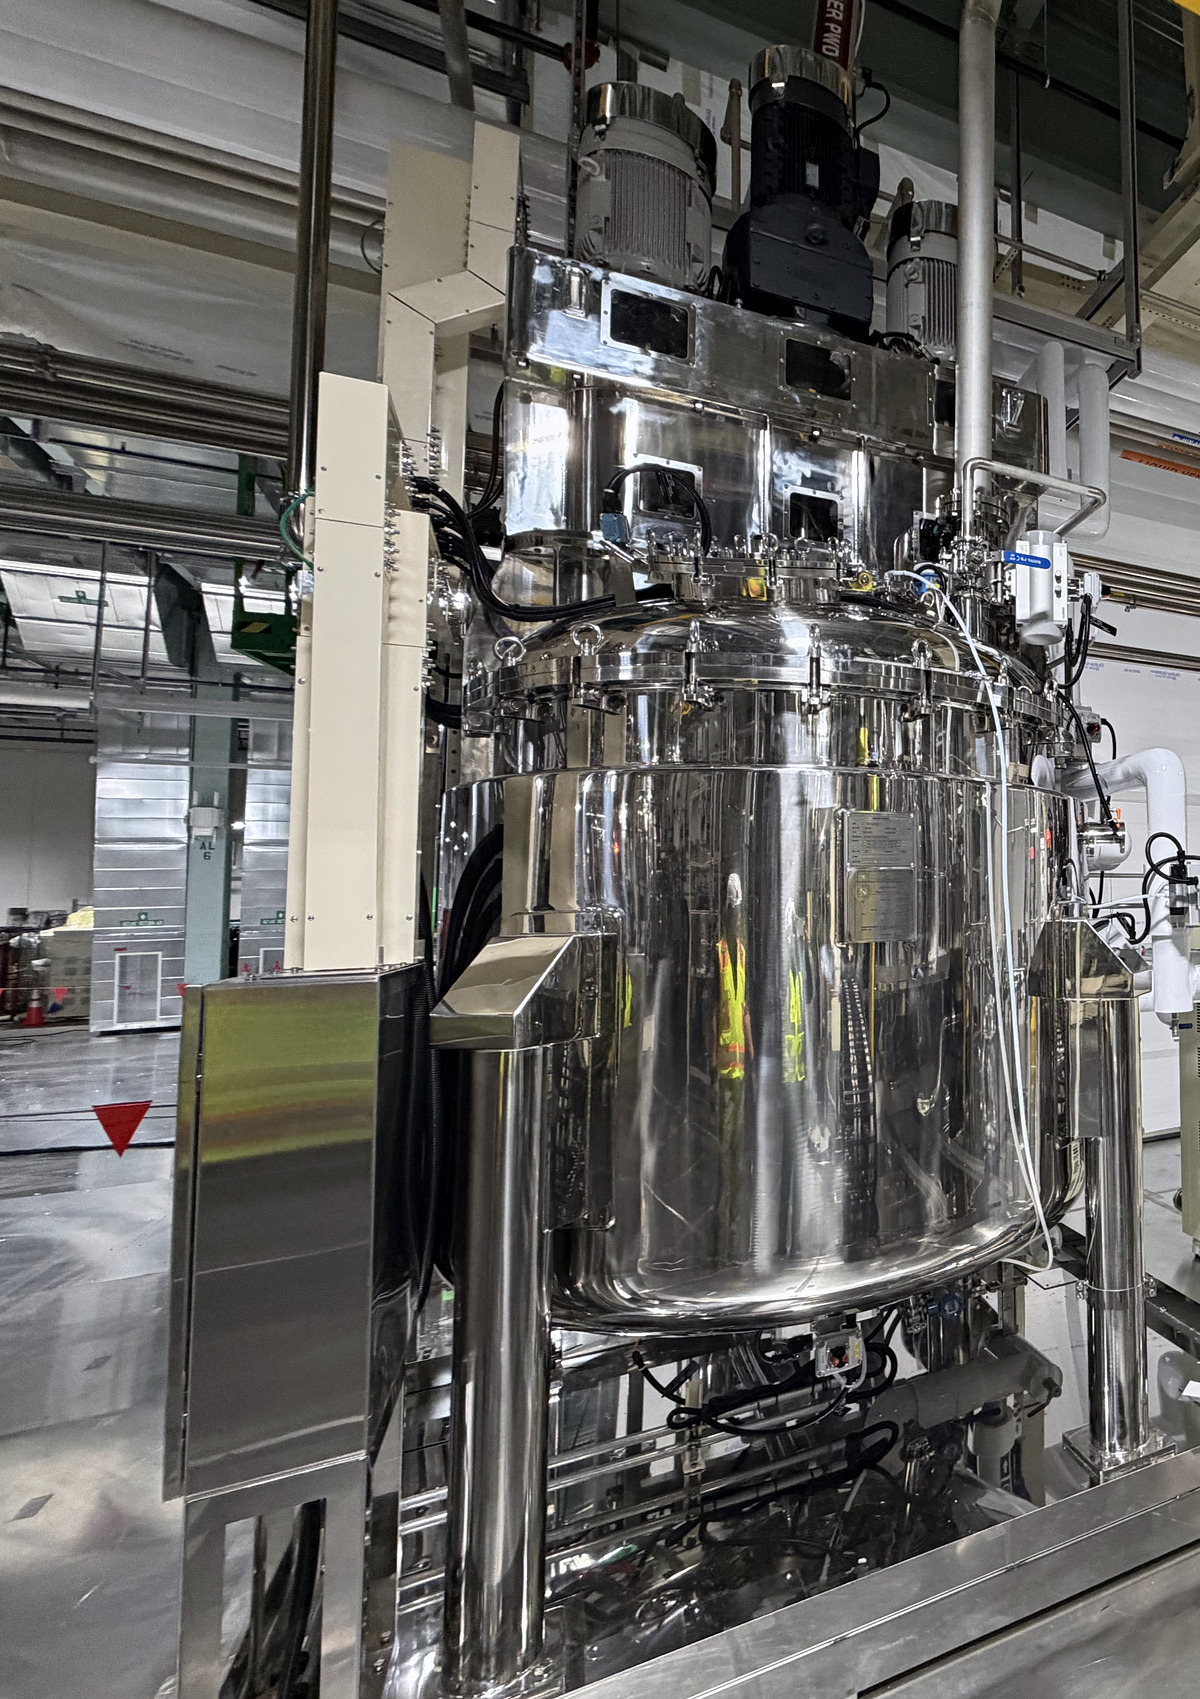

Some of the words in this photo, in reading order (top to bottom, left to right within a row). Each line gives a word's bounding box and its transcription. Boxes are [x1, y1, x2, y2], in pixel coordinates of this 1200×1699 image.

[822, 23, 842, 57] PWD
[199, 841, 216, 850] AL
[203, 851, 212, 860] 6
